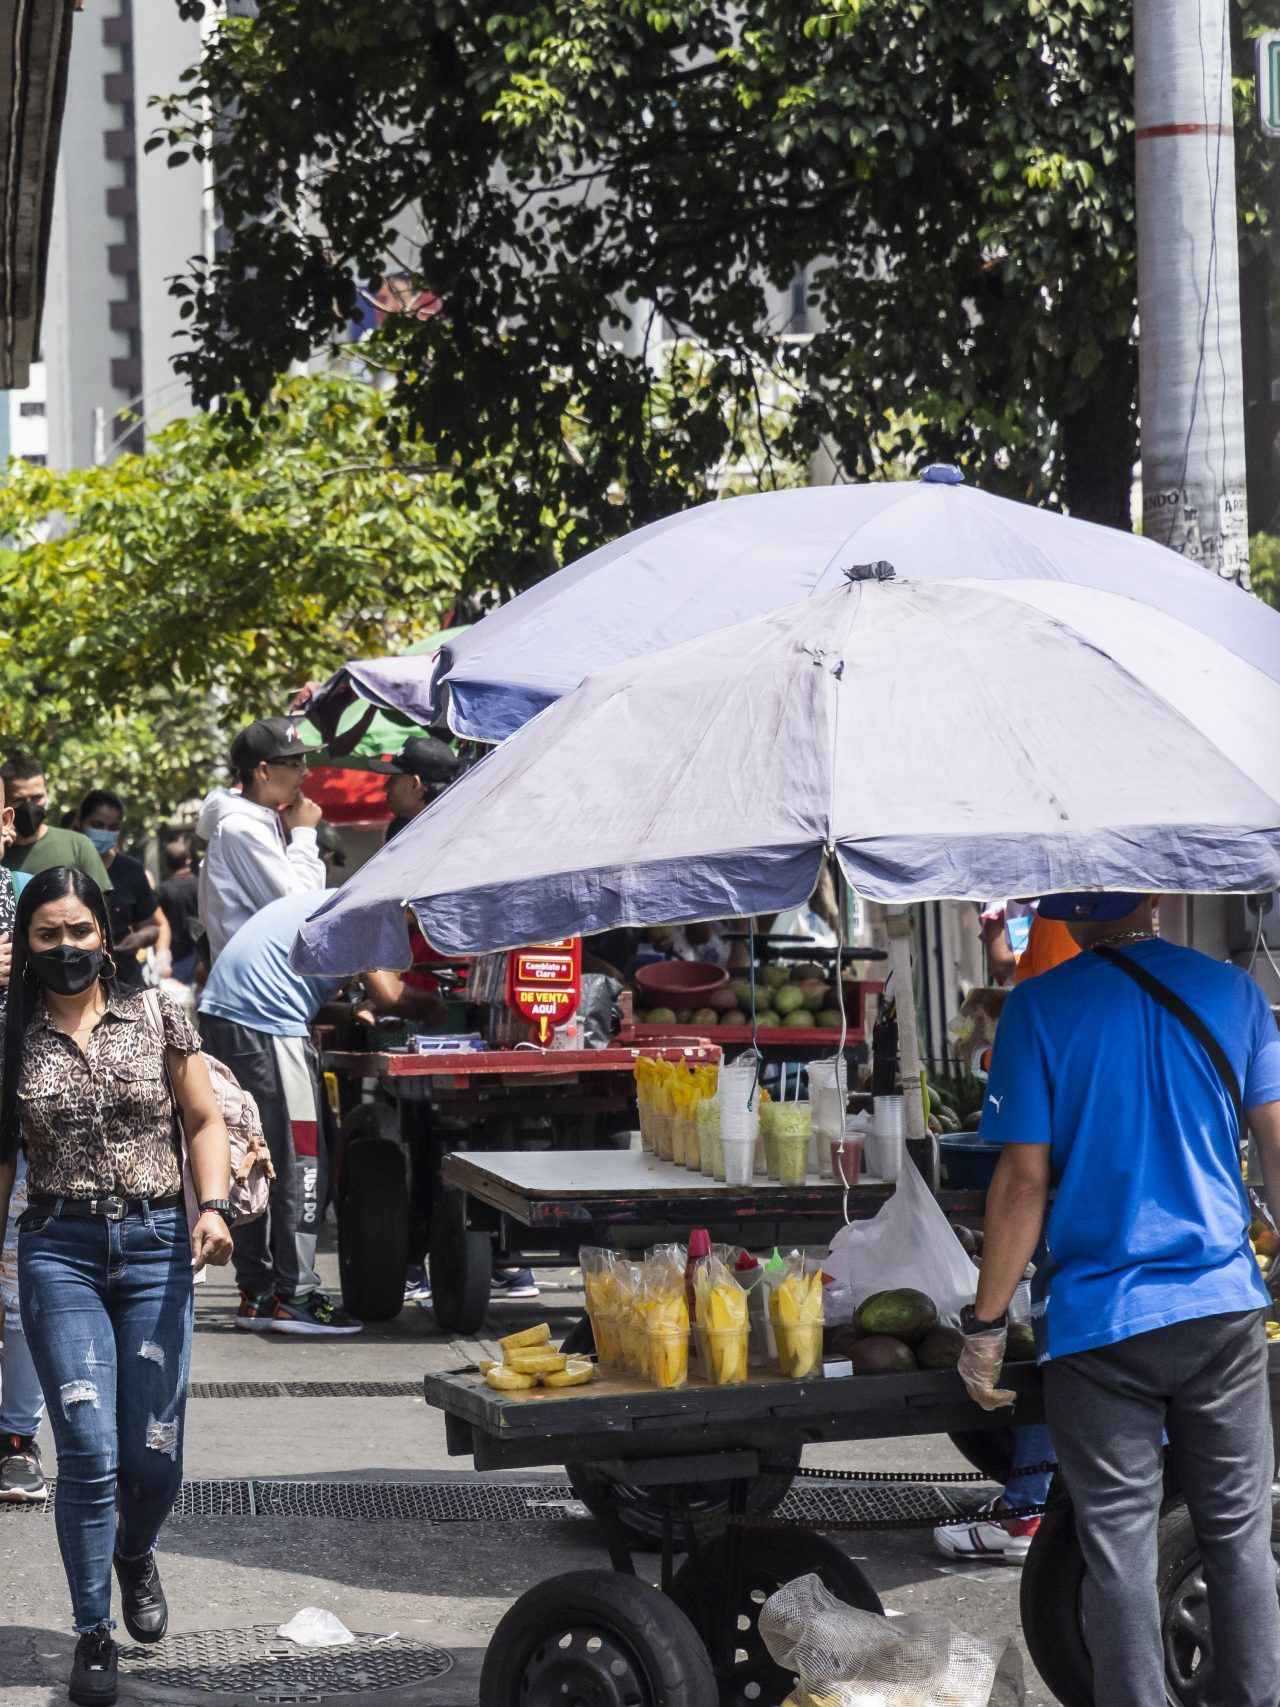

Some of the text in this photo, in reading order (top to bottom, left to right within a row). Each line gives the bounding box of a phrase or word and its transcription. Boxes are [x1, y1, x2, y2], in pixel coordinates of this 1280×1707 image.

[520, 992, 569, 1003] DE VENTA
[531, 1003, 557, 1014] AQUÍ
[303, 1166, 317, 1223] JUST DO
